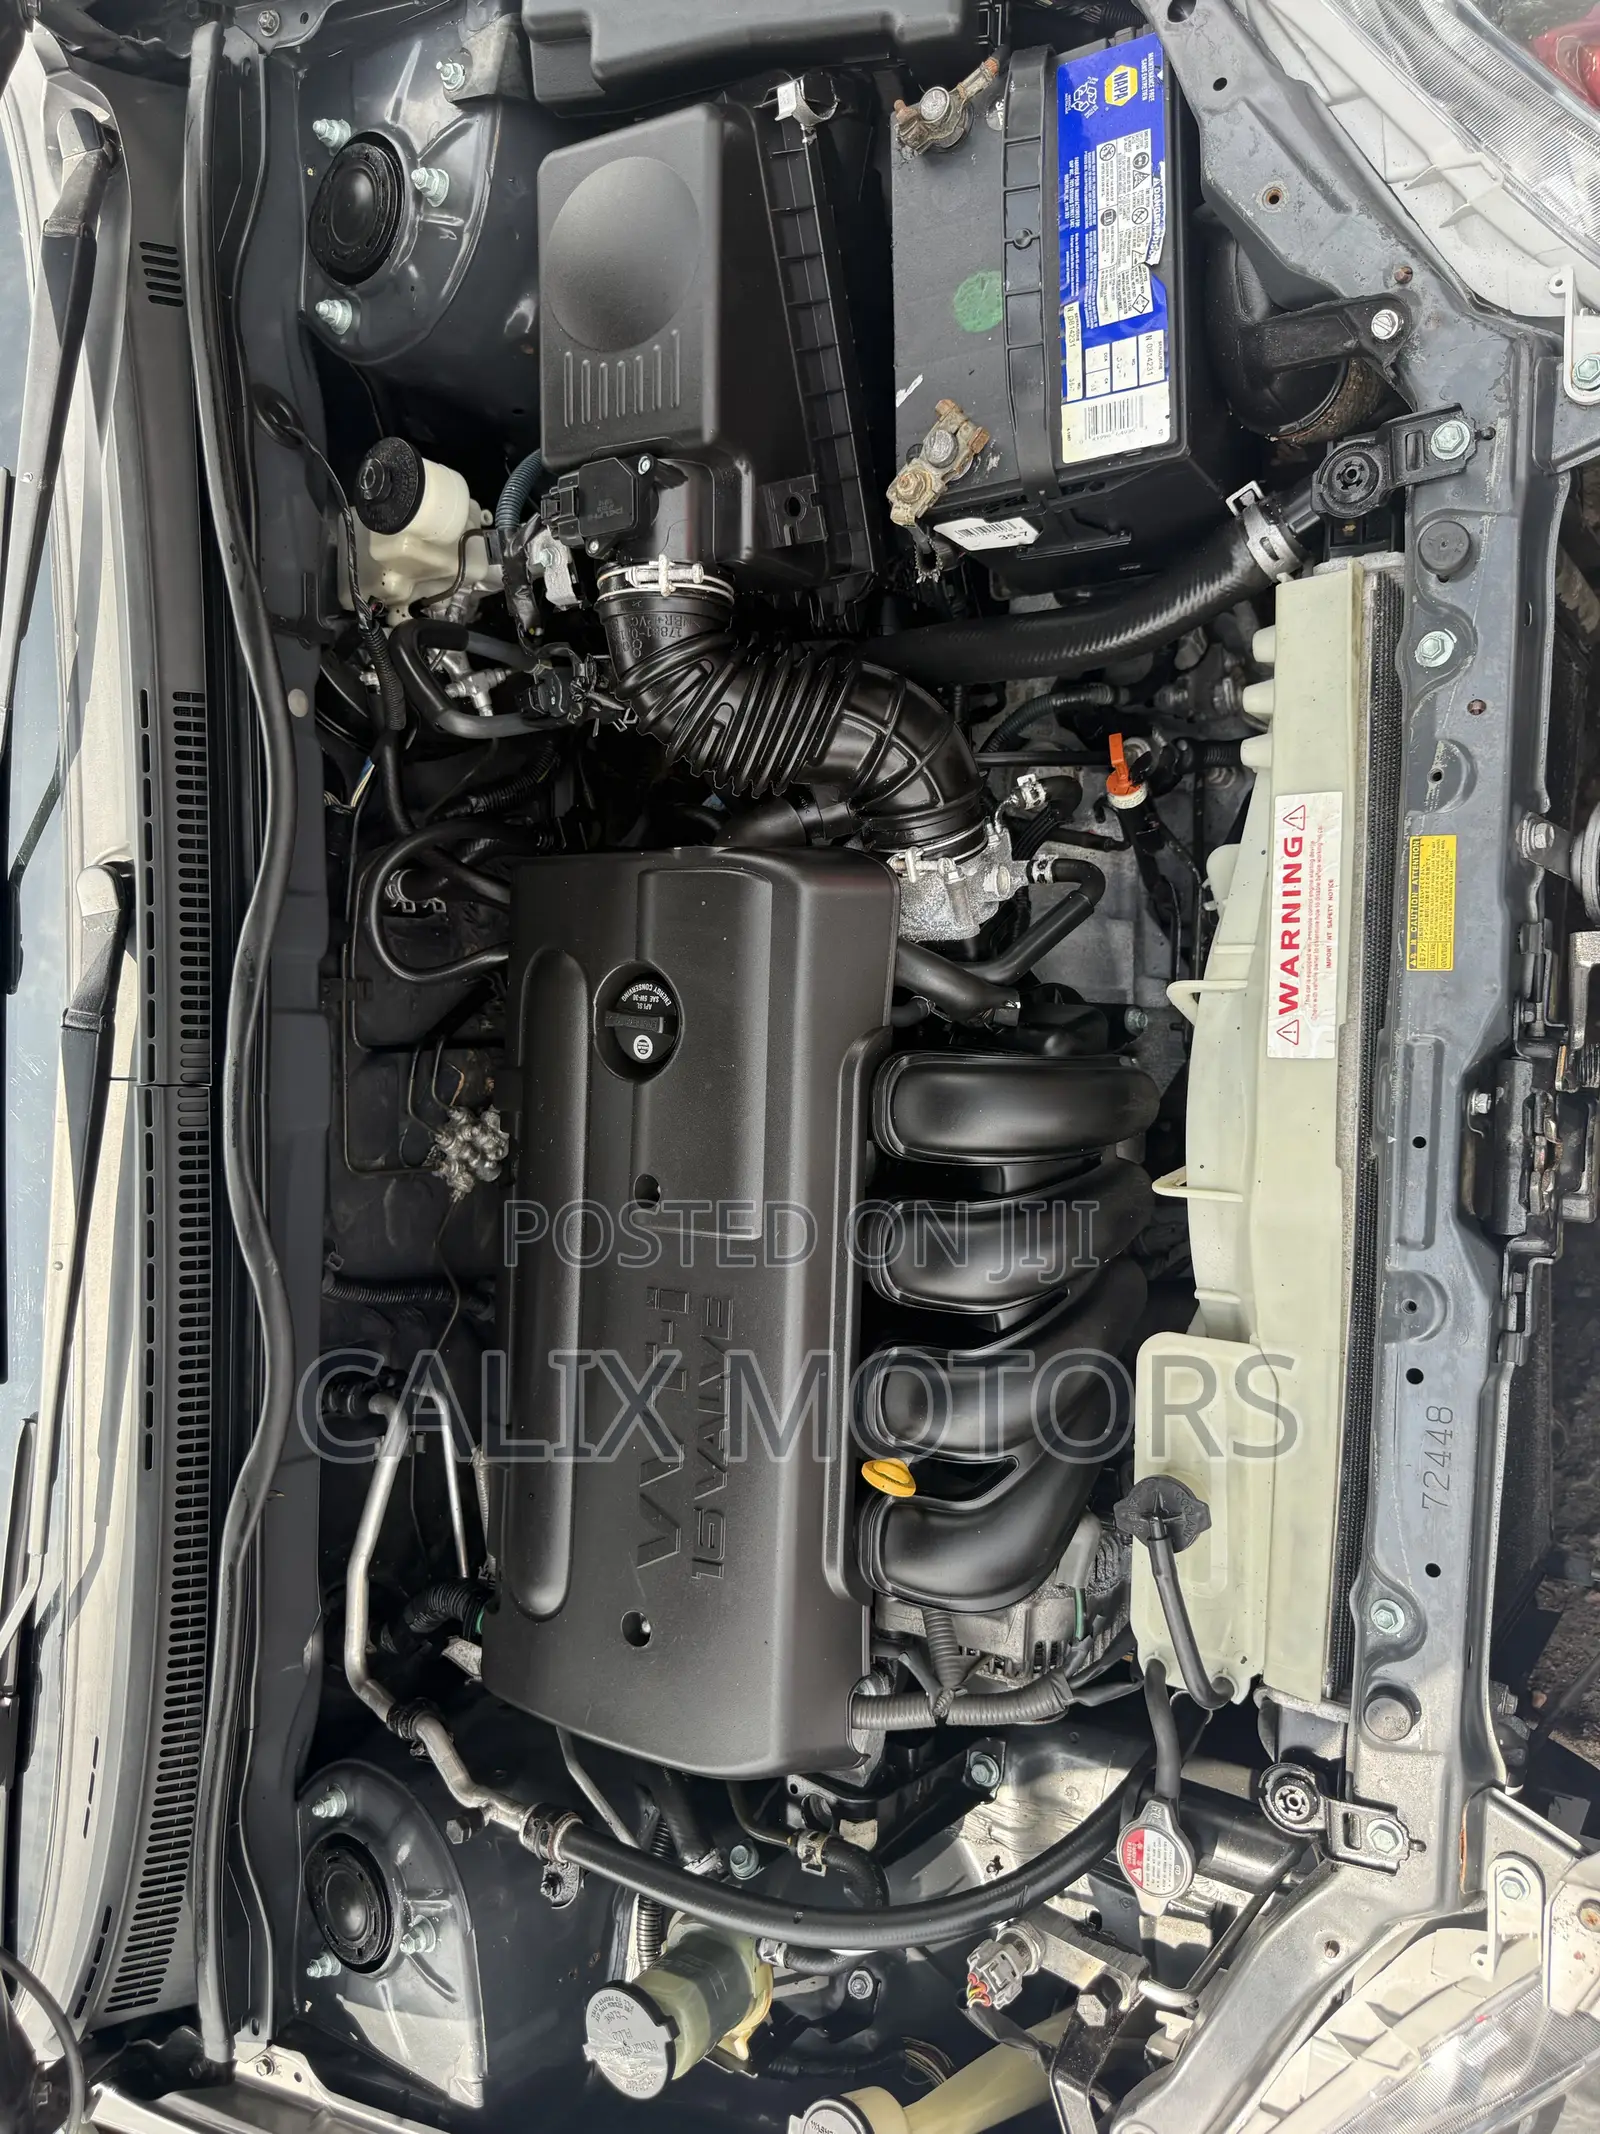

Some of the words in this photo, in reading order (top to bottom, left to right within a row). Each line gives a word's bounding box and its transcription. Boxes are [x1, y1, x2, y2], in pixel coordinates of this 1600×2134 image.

[1113, 71, 1129, 101] NAPA
[1068, 315, 1076, 347] 0814231
[1411, 840, 1420, 885] ATTENTION
[1279, 836, 1303, 1015] WARNING
[1410, 892, 1419, 932] CAUTION
[1325, 932, 1333, 969] IMPORTNT
[621, 983, 653, 1002] CONSERVING
[633, 994, 648, 1002] 5W-30
[650, 995, 659, 1003] SAE
[653, 984, 672, 1006] ENERGY
[694, 1296, 733, 1501] VALVE
[1421, 1405, 1454, 1510] 72448
[691, 1507, 725, 1580] 16
